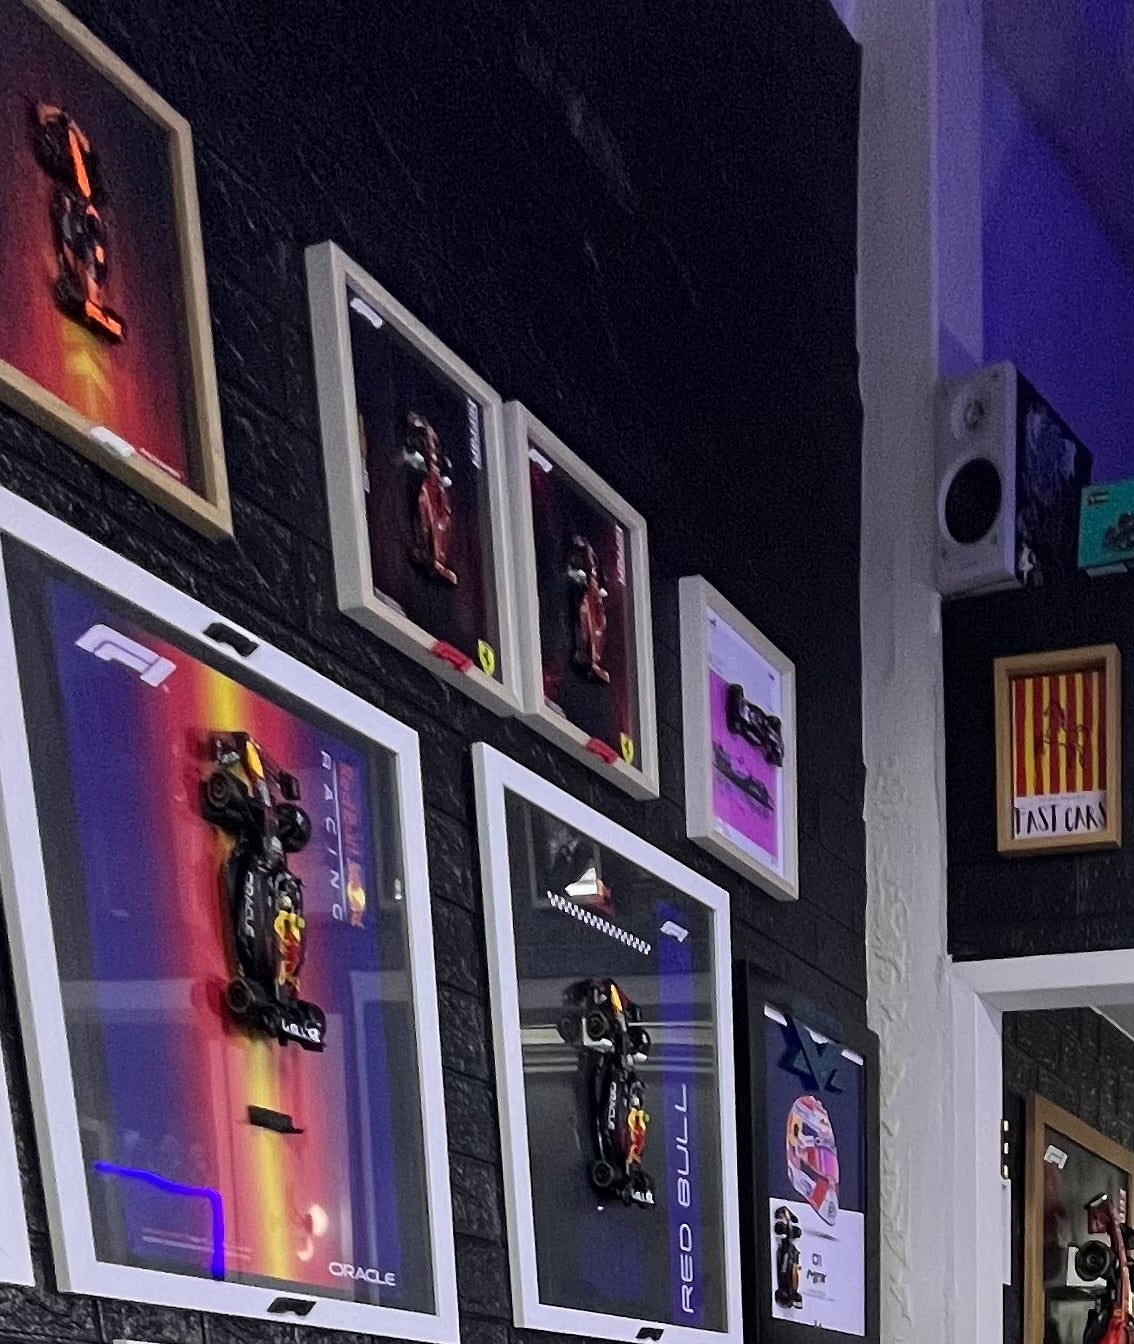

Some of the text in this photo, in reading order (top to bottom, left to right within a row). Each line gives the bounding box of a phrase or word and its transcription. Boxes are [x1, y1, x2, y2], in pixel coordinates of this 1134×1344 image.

[1014, 800, 1107, 835] FAST CARS
[674, 1083, 695, 1314] RED BULL
[328, 1261, 396, 1287] ORACLE
